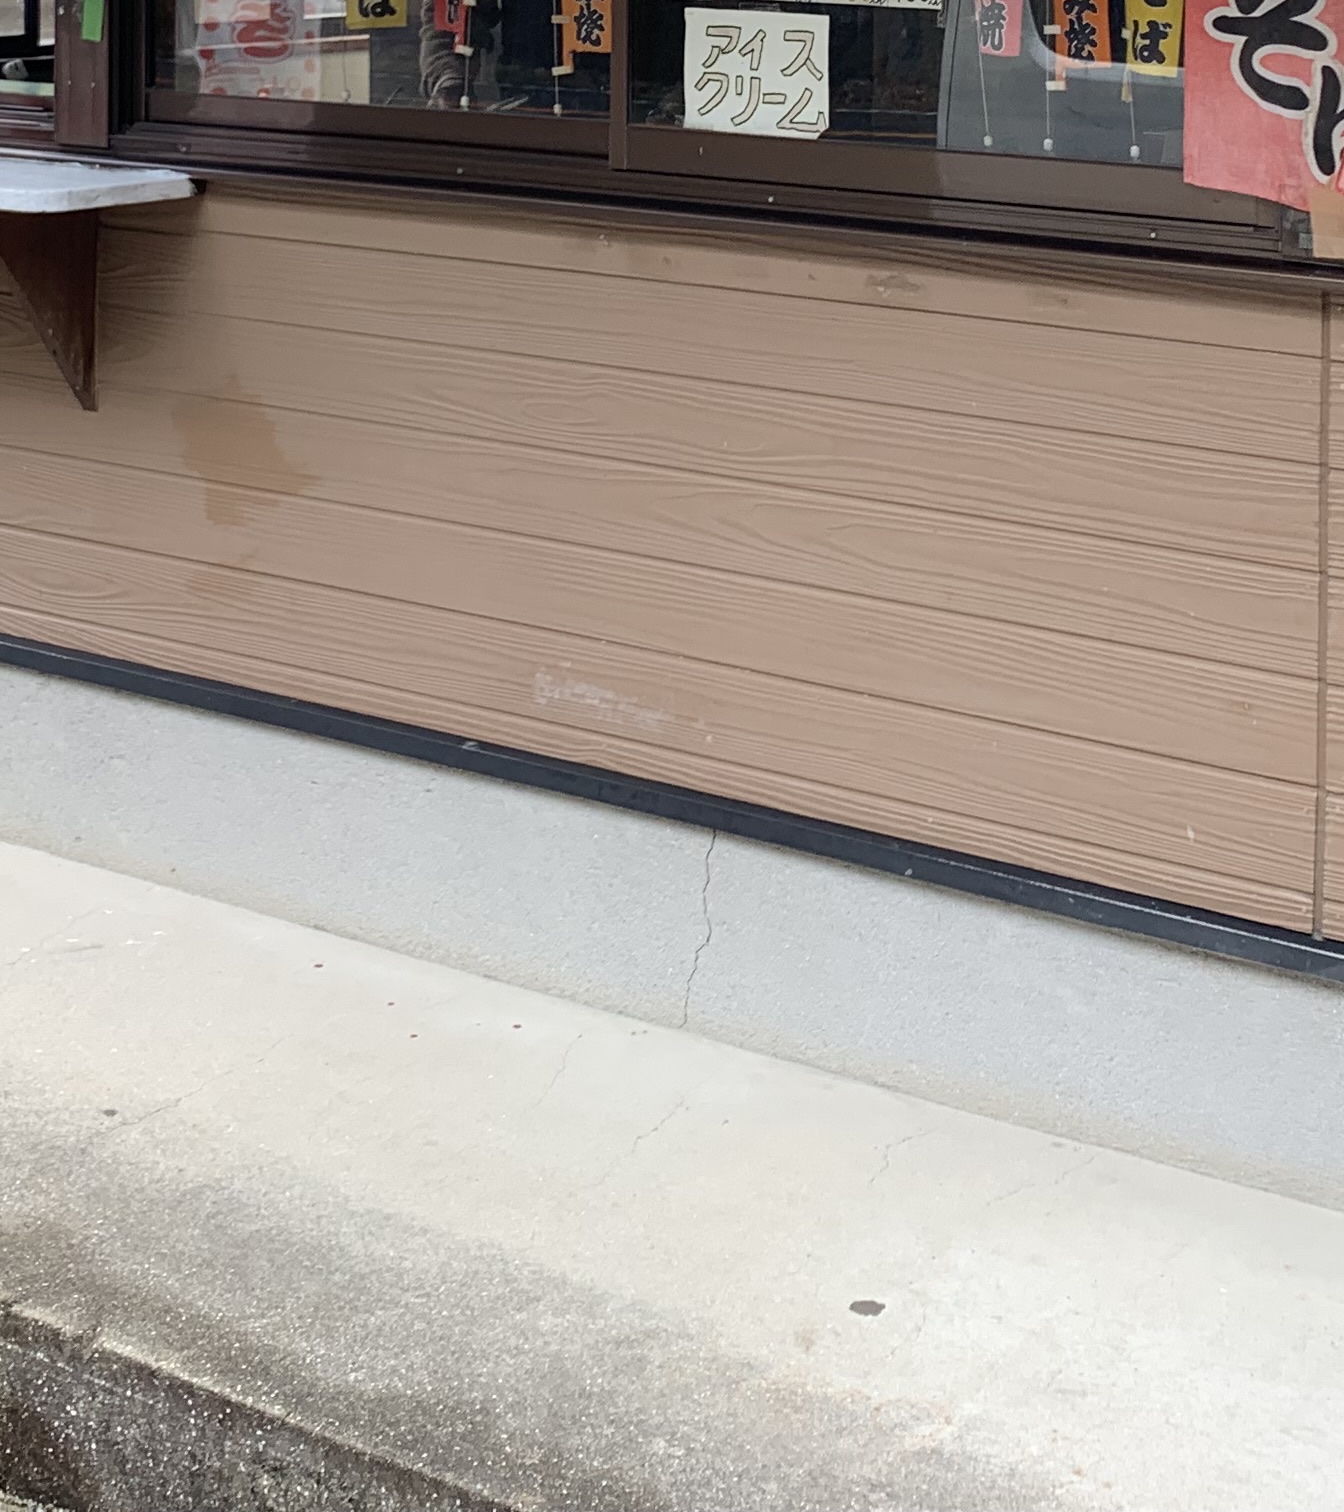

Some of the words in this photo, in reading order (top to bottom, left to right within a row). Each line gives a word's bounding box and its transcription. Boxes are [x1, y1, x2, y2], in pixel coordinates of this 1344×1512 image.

[703, 24, 824, 83] アイス
[692, 70, 827, 134] クリーム
